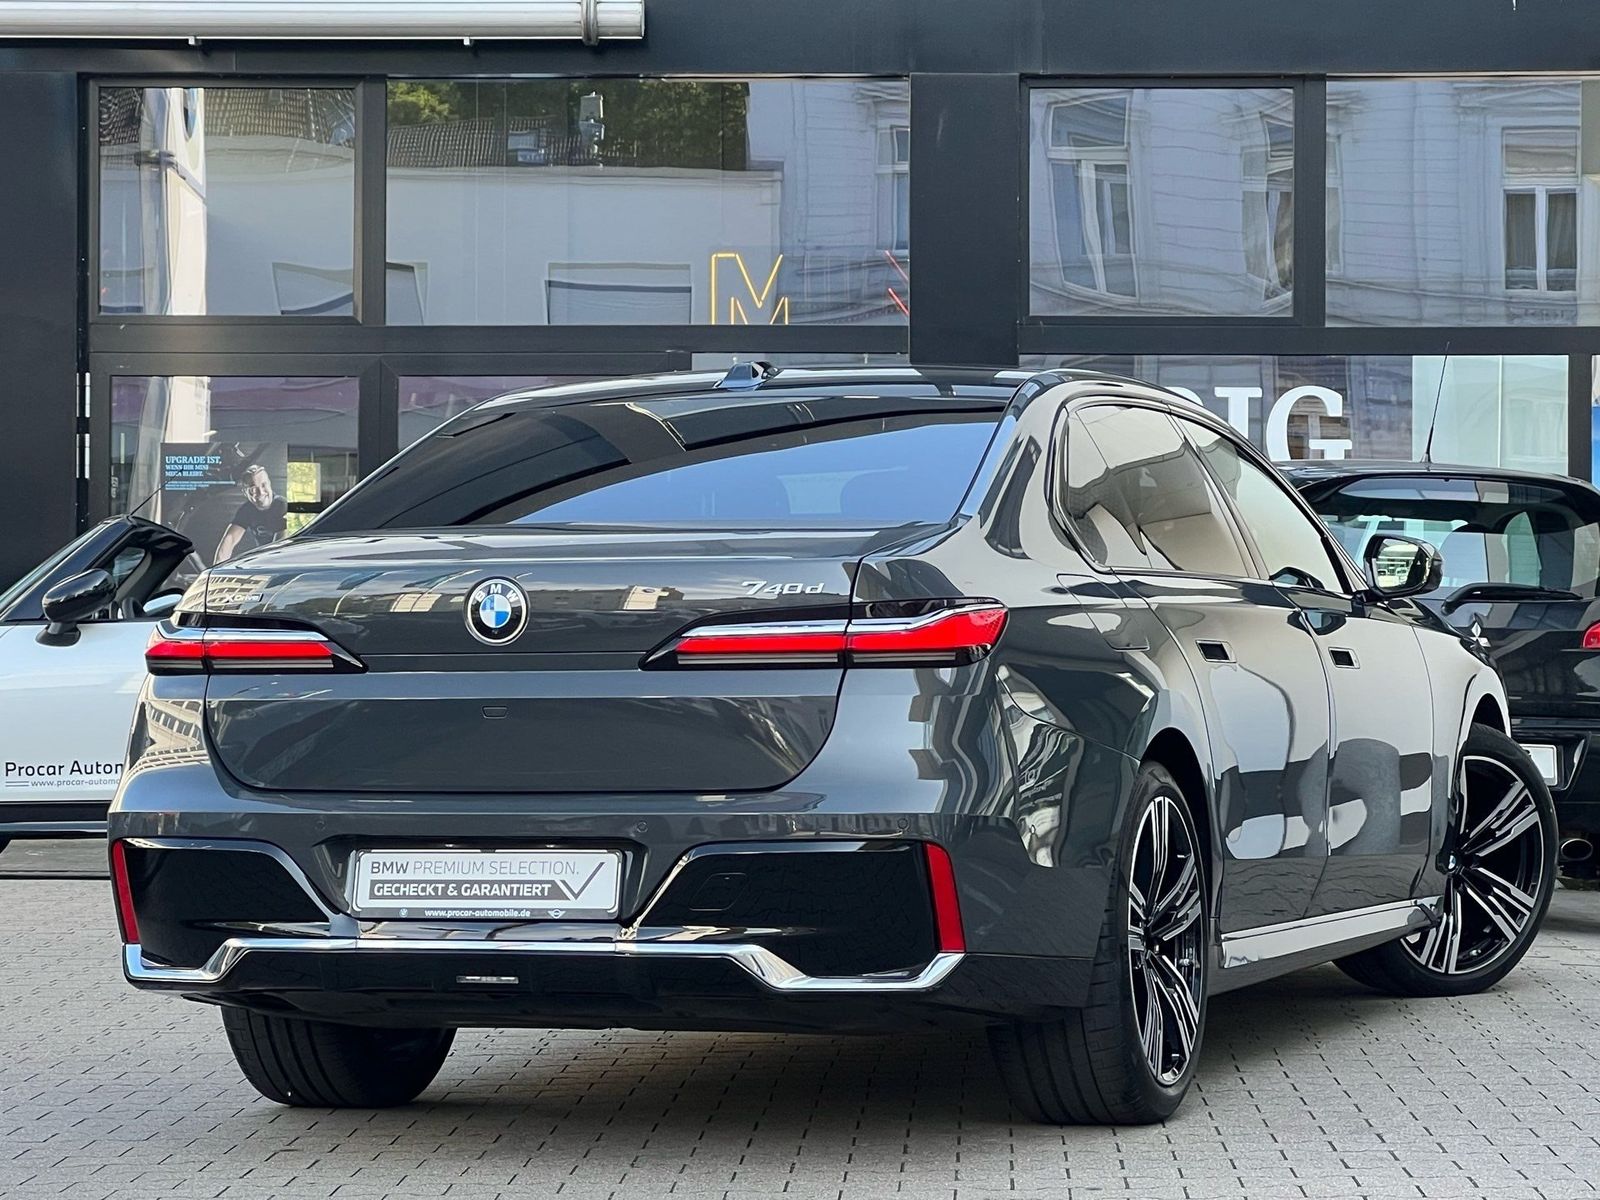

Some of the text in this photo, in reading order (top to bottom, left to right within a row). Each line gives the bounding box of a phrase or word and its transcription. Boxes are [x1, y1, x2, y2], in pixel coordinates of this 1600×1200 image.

[1164, 385, 1353, 461] IG
[165, 456, 205, 464] UPGRADE
[475, 583, 519, 603] BMW
[741, 580, 825, 595] 740d
[5, 762, 65, 777] Procar
[370, 861, 580, 875] BMW PREMIUM SELECTION.
[374, 883, 552, 896] GECHECKT & GARANTIERT
[424, 909, 531, 918] www.procar-automobile.de
